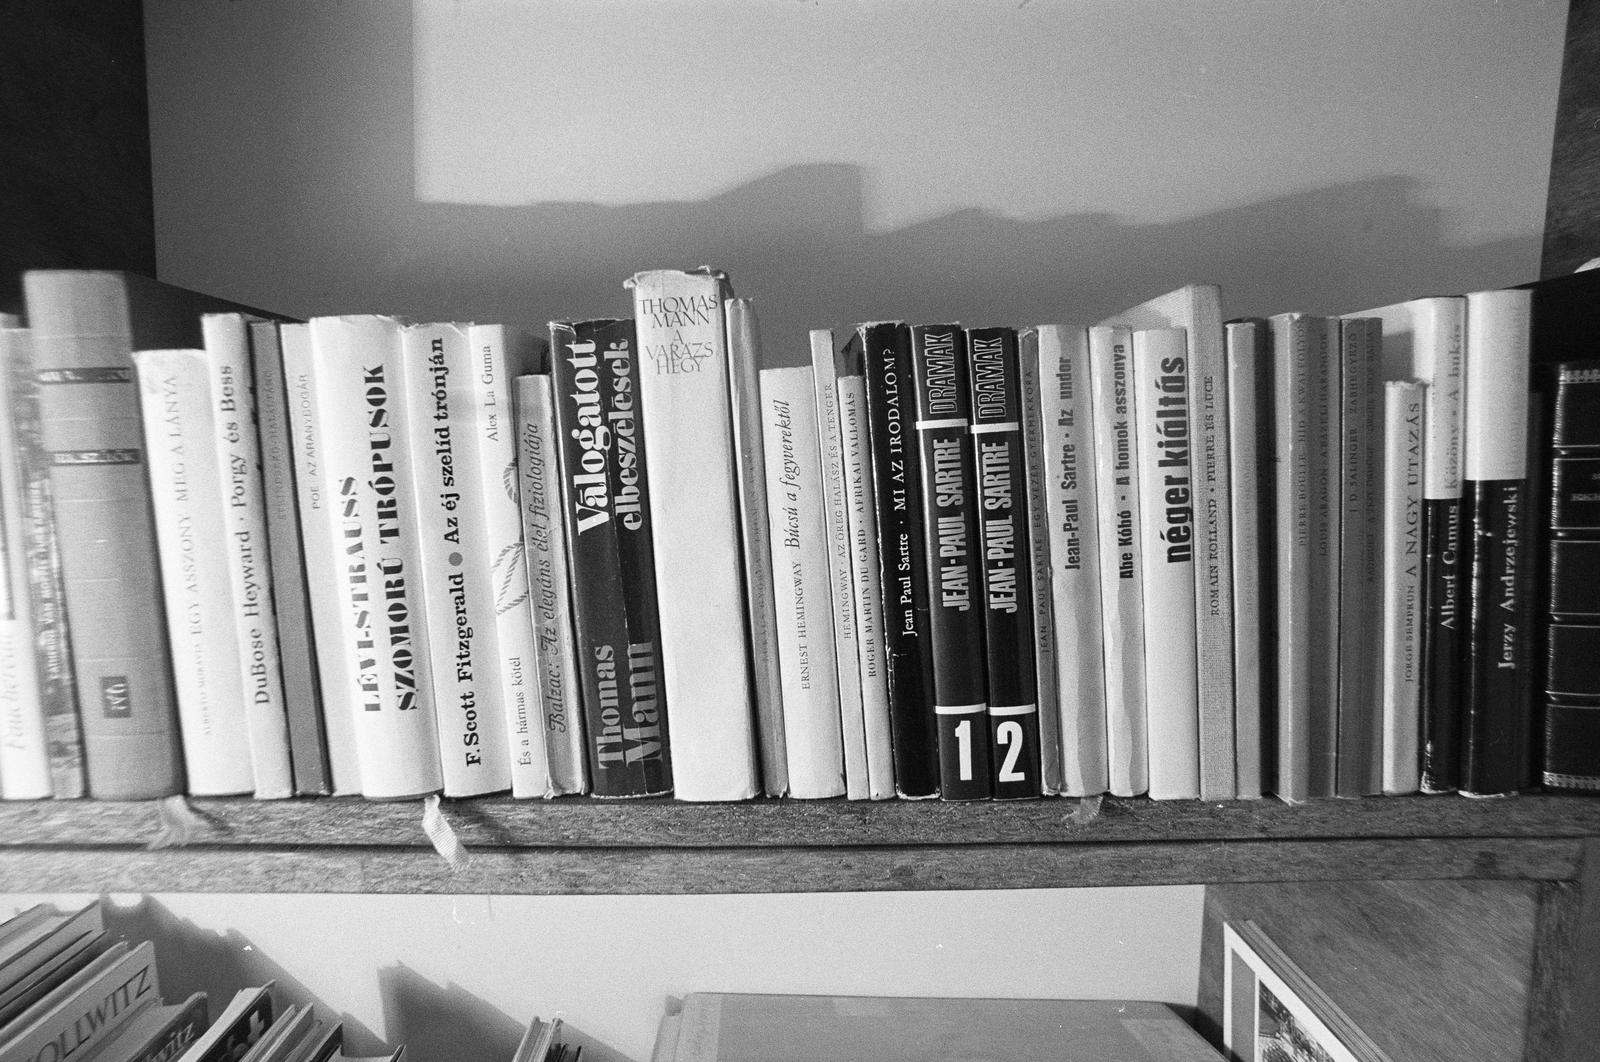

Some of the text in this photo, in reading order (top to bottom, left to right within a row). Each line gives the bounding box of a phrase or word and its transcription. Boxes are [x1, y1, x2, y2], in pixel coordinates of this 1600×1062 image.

[640, 295, 718, 314] THOMAS
[652, 311, 710, 328] MANN
[656, 357, 704, 375] HEGY
[673, 329, 685, 345] A
[428, 338, 450, 422] trónján
[480, 345, 500, 442] Alex La Guma
[1203, 375, 1215, 409] LUCE
[297, 374, 321, 510] POE AZ ARANYBOGÁR
[564, 338, 614, 536] Válogatott
[603, 339, 643, 531] elbeszélések
[1024, 370, 1038, 459] GYERMEKKORA
[1402, 402, 1421, 488] UTAZÁS
[170, 445, 184, 455] A
[433, 427, 455, 488] szelíd
[1054, 356, 1081, 571] Jean-Paul Sartre Az undor
[1111, 344, 1135, 580] Abe Kóbó A homok asszonya
[1153, 356, 1194, 563] néger kiáltás
[1205, 434, 1217, 482] PIERRE
[1297, 454, 1307, 500] BOULLE
[1348, 427, 1359, 487] SALINGER
[171, 462, 190, 502] MEG
[442, 492, 460, 512] éj
[824, 382, 852, 640] HEMINGWAY AZ ÖREG HALÁSZ ÉS A TENGER
[882, 347, 919, 637] Jean Paul Sartre MI AZ IRODALOM?
[1028, 464, 1042, 501] VEZÉR
[218, 365, 271, 705] DuBose Heyward Porgy és Bess
[366, 364, 418, 711] SZOMORÚ TRÓPUSOK
[444, 523, 460, 545] Az
[772, 398, 812, 691] ERNEST HEMINGWAY Búcsú a fegyverektől
[844, 391, 877, 678] ROGER MARTIN DU GARD AFRIKAI VALLOMÁS
[932, 437, 971, 612] JEAN-PAUL SARTRE
[980, 441, 1019, 614] JEAN-PAUL SARTRE
[1031, 504, 1043, 528] EGY
[1207, 498, 1219, 561] ROLLAND
[1297, 506, 1307, 546] PIERRE
[1404, 495, 1420, 555] NAGY
[1441, 503, 1459, 565] Camus
[177, 513, 200, 593] ASSZONY
[521, 422, 568, 735] Balzac: Az elegáns élet fiziologiája
[1404, 564, 1418, 578] A
[1499, 487, 1520, 613] Andrzejewski
[187, 602, 203, 636] EGY
[337, 476, 381, 712] LÉVI-STRAUSS
[1209, 565, 1221, 616] ROMAIN
[1440, 574, 1458, 631] Albert
[447, 572, 474, 684] Fitzgerald
[1497, 622, 1518, 672] Jerzy
[508, 657, 523, 688] kötél
[1403, 645, 1415, 682] JORGE
[511, 692, 528, 734] hármas
[593, 642, 626, 770] Thomas
[626, 640, 663, 769] Mann
[517, 751, 532, 767] És
[953, 719, 972, 781] 1
[996, 719, 1026, 783] 2
[28, 964, 152, 1062] OLLWITZ
